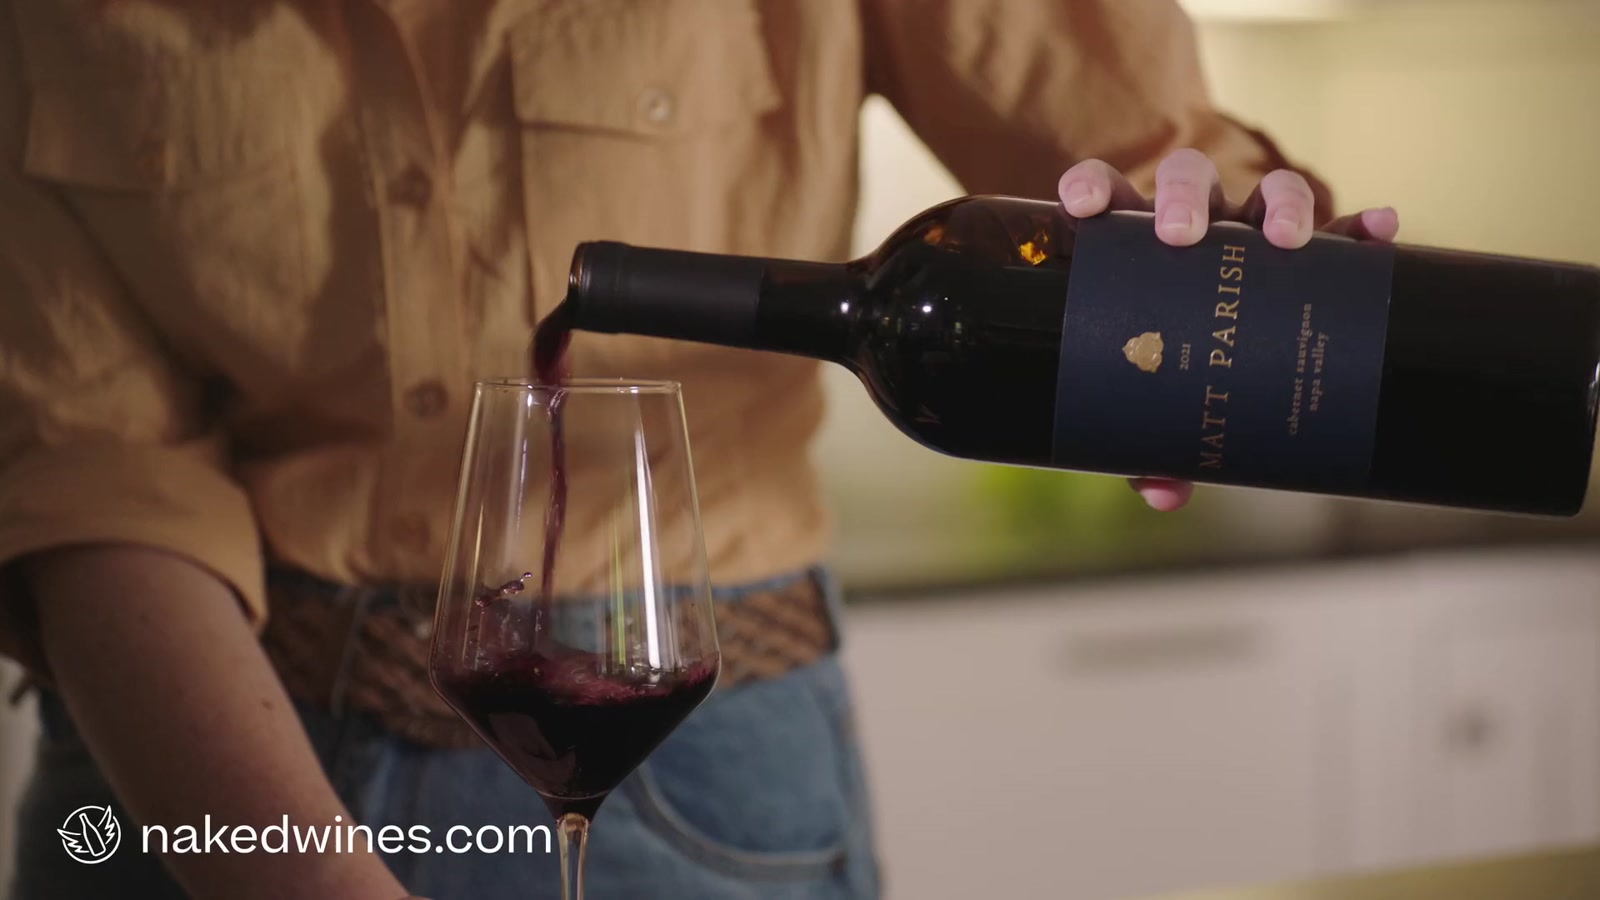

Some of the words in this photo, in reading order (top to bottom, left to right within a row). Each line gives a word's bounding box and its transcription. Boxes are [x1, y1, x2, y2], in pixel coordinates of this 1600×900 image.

[1209, 244, 1246, 369] PARISH
[1180, 343, 1192, 371] 2021
[1287, 378, 1304, 436] cabernet
[1296, 303, 1313, 373] sauvignon
[1311, 332, 1330, 374] valley
[1199, 385, 1230, 469] MATT
[1310, 379, 1324, 412] napa
